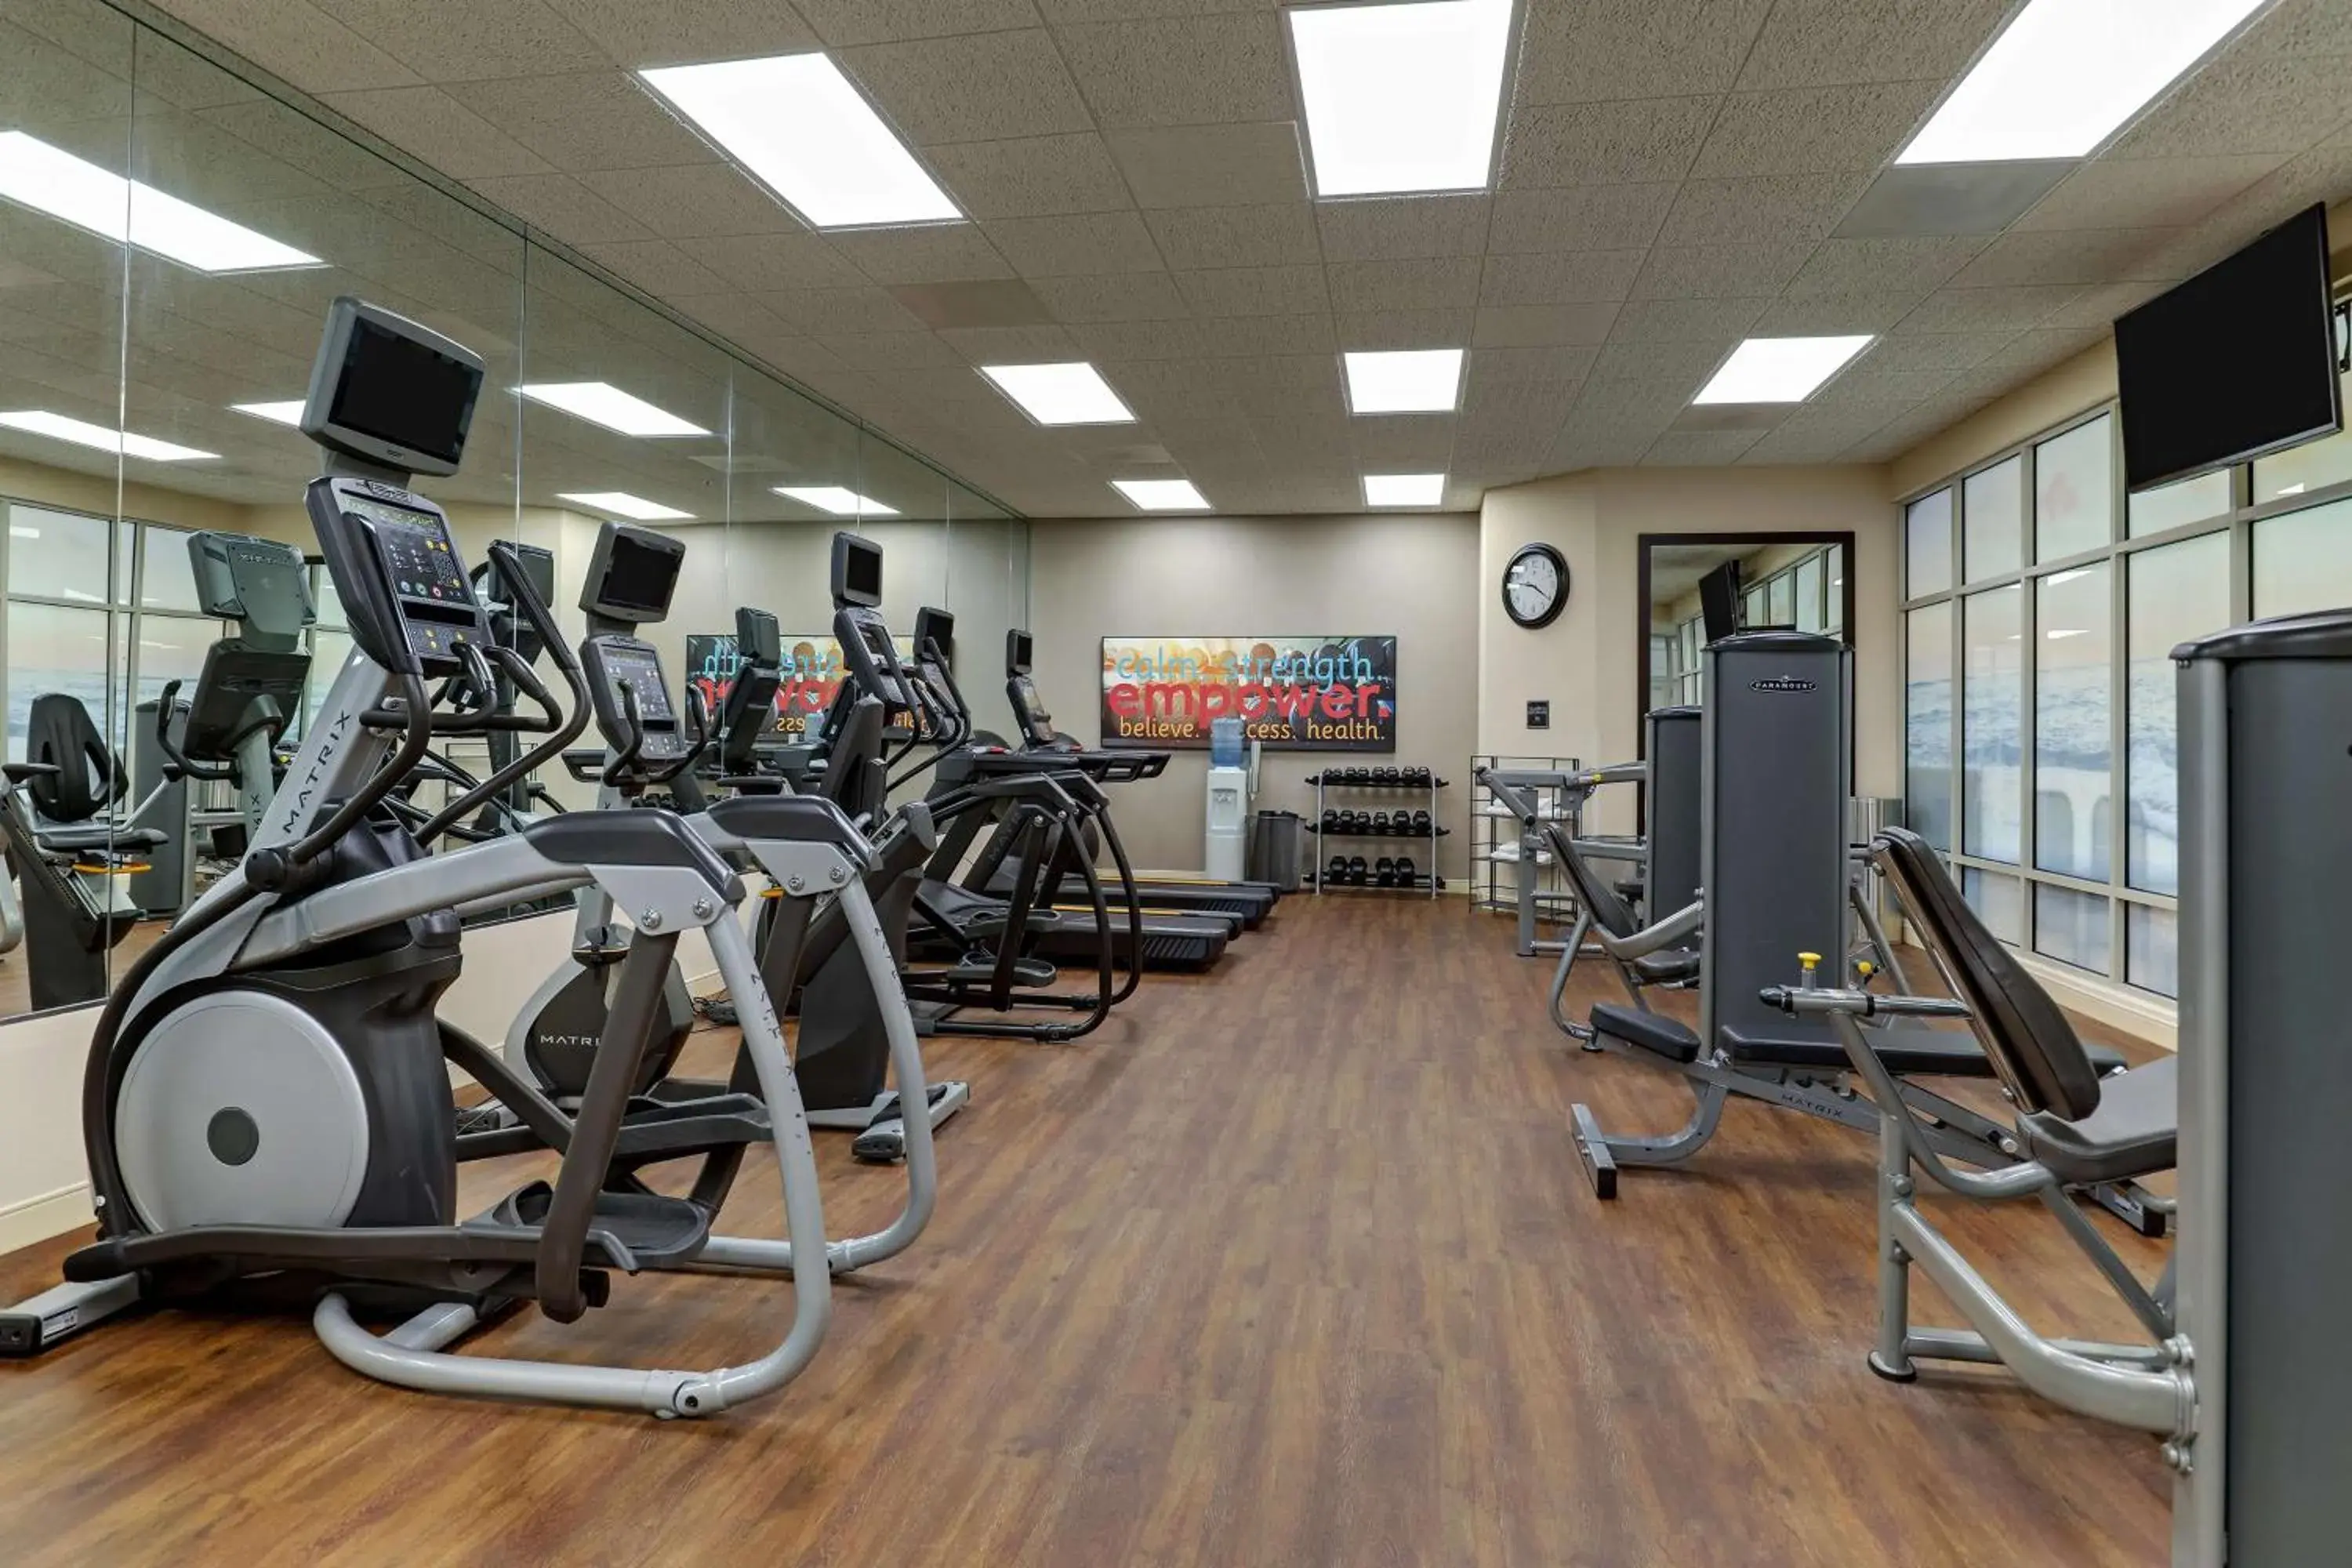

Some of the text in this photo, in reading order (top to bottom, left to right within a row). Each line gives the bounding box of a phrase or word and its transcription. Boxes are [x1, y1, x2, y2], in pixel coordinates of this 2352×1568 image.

[1109, 682, 1391, 729] empower.
[1120, 715, 1385, 740] believe. cess. health.
[281, 710, 351, 833] MATRIX
[539, 1035, 601, 1047] MATRI
[1781, 1094, 1842, 1117] MATRIX
